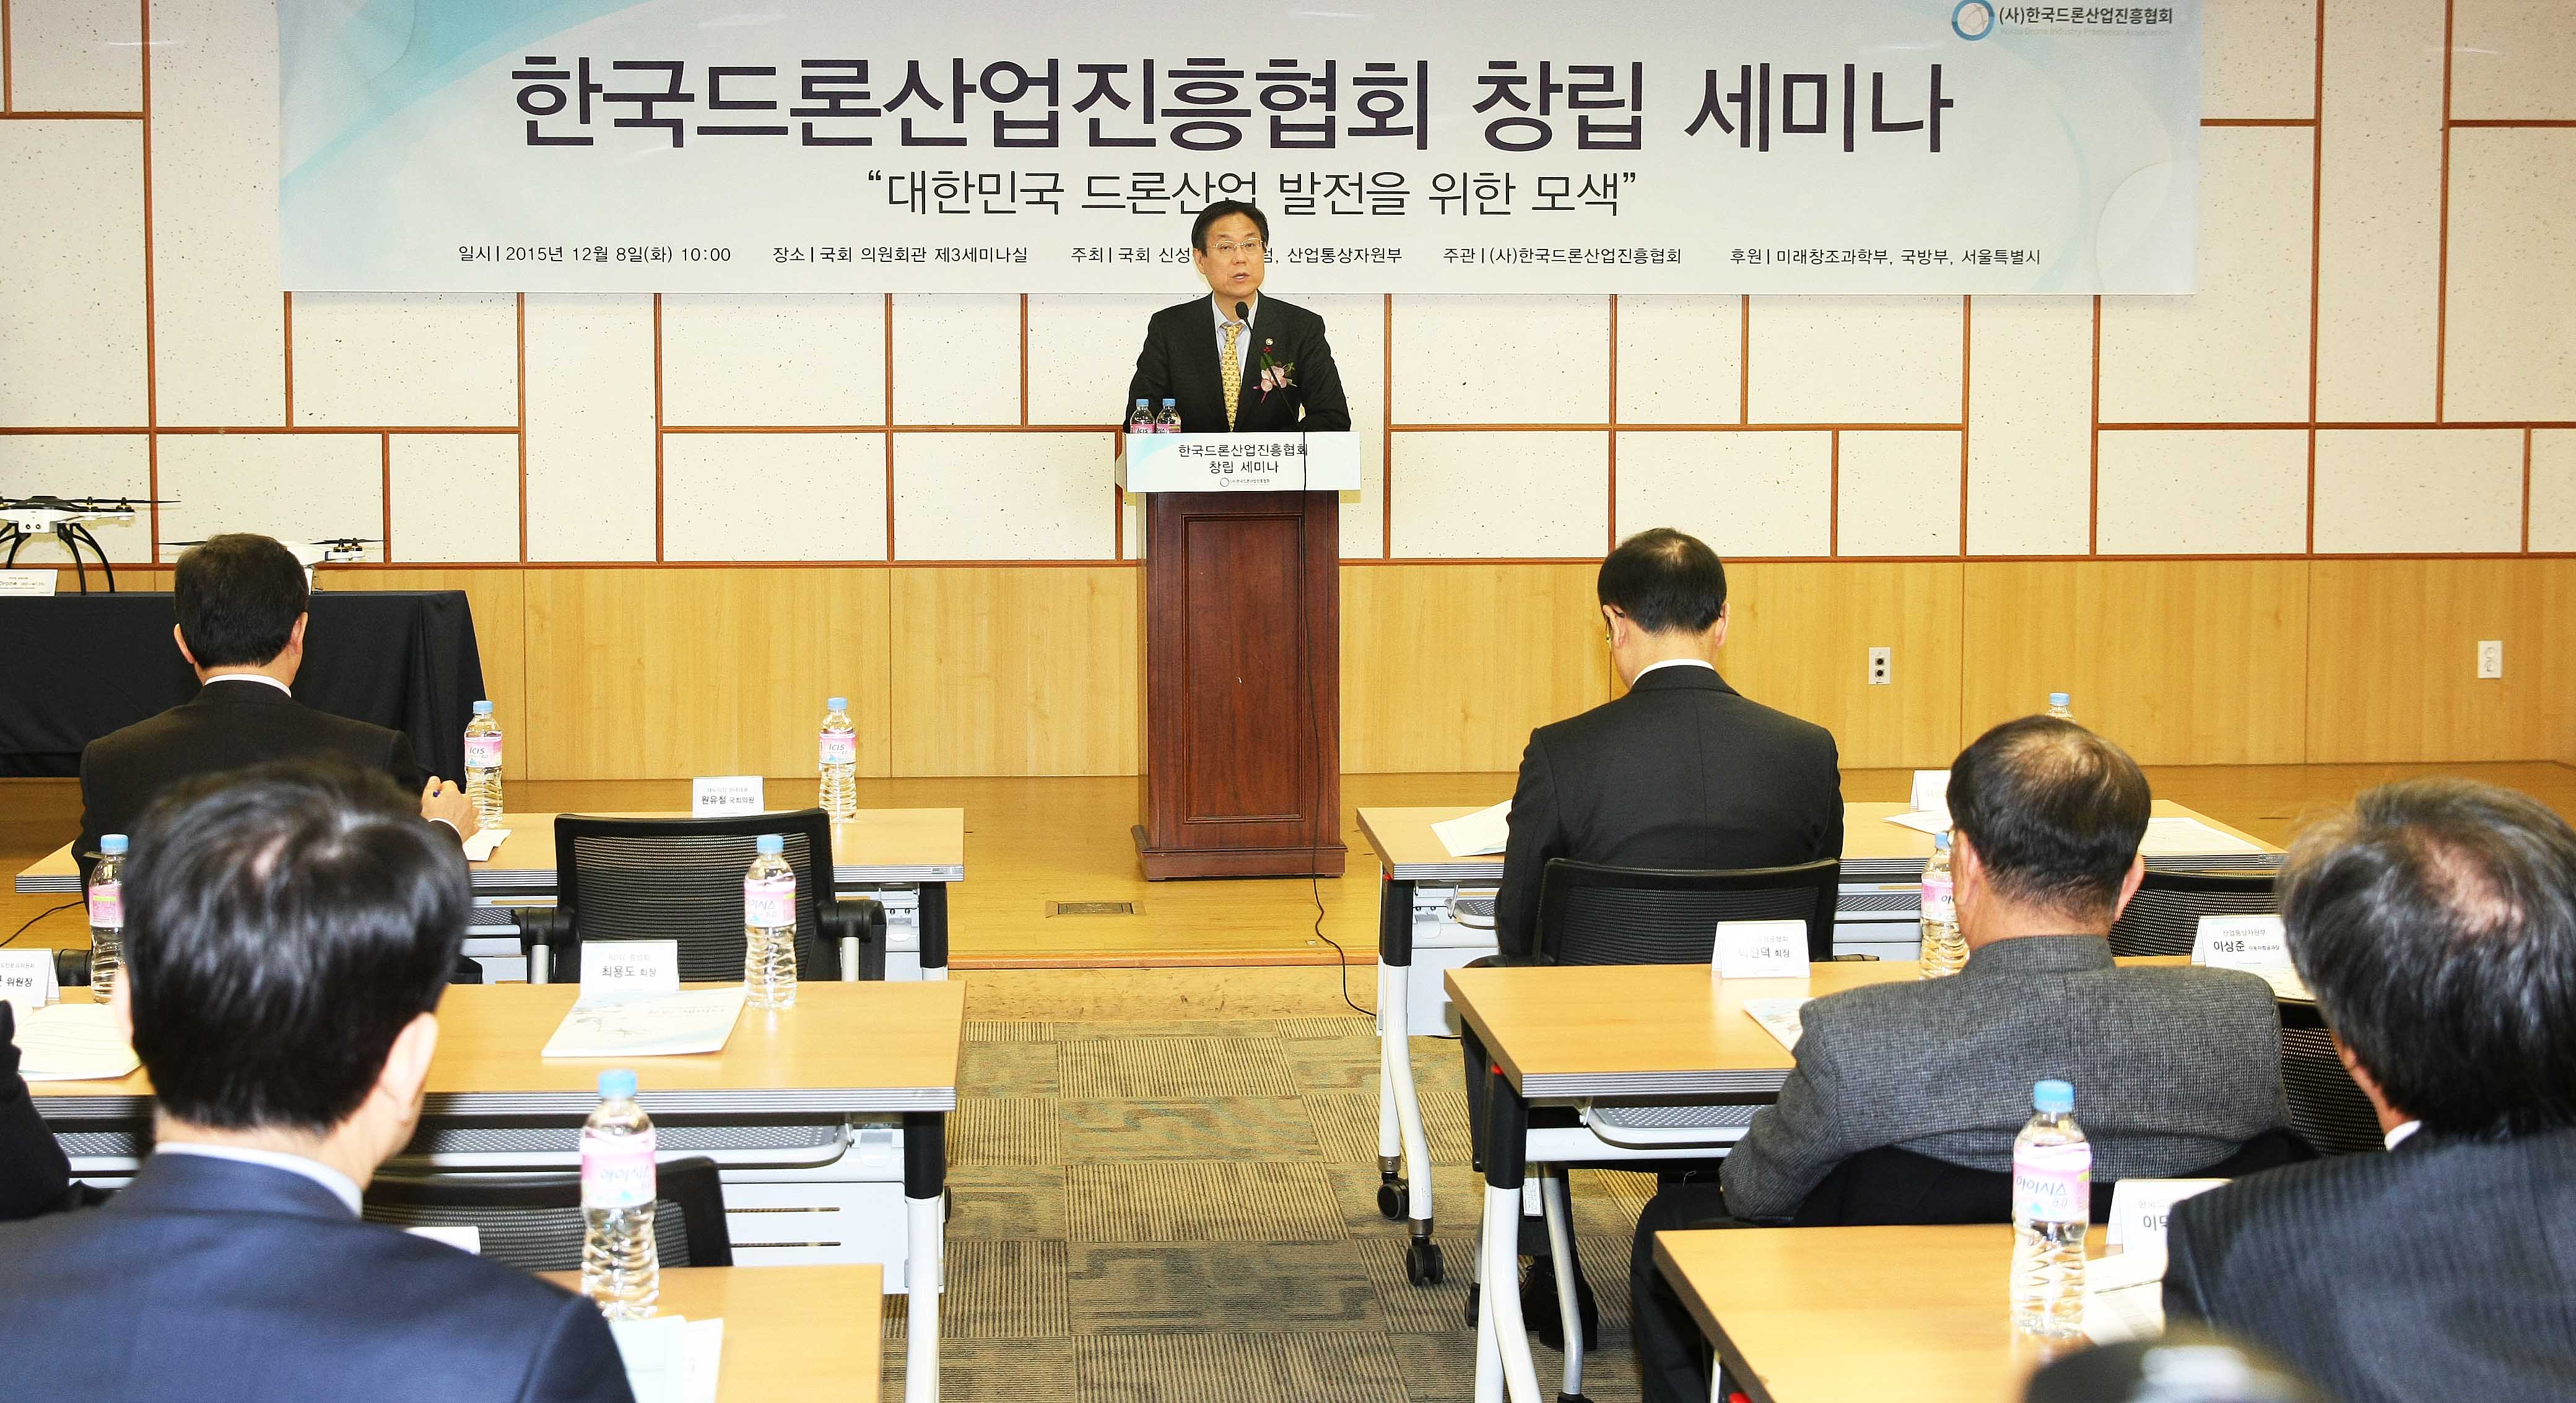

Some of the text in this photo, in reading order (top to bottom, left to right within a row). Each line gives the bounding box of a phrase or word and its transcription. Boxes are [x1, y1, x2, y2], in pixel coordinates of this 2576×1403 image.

[1999, 7, 2173, 25] (사)한국드론산업진흥협회
[512, 56, 1954, 153] 한국드론산업진흥협회 창립 세미나
[1279, 172, 1410, 216] 발전을
[1429, 173, 1516, 216] 위한
[573, 246, 608, 263] 12월
[617, 246, 672, 263] 8일(화)
[682, 248, 731, 261] 10:00
[820, 246, 851, 263] 국회
[861, 246, 927, 263] 의원회관
[935, 246, 1027, 263] 제3세미나실
[1118, 247, 1149, 263] 국회
[1159, 247, 1190, 264] 신성
[1288, 247, 1403, 264] 산업통상자원부
[1490, 247, 1681, 264] (사)한국드론산업진흥협회
[1777, 249, 1892, 265] 미래창조과학부,
[1902, 249, 1953, 266] 국방부,
[1962, 249, 2040, 265] 서울특별시
[1178, 443, 1308, 458] 한국드론산업진흥협회
[1209, 460, 1279, 474] 창립 세미나
[701, 795, 754, 805] 원유철 국회의원
[2213, 940, 2247, 953] 이상준
[601, 965, 657, 979] 최용도 회장
[6, 976, 33, 988] 위원장
[2016, 1175, 2067, 1196] 아이시스
